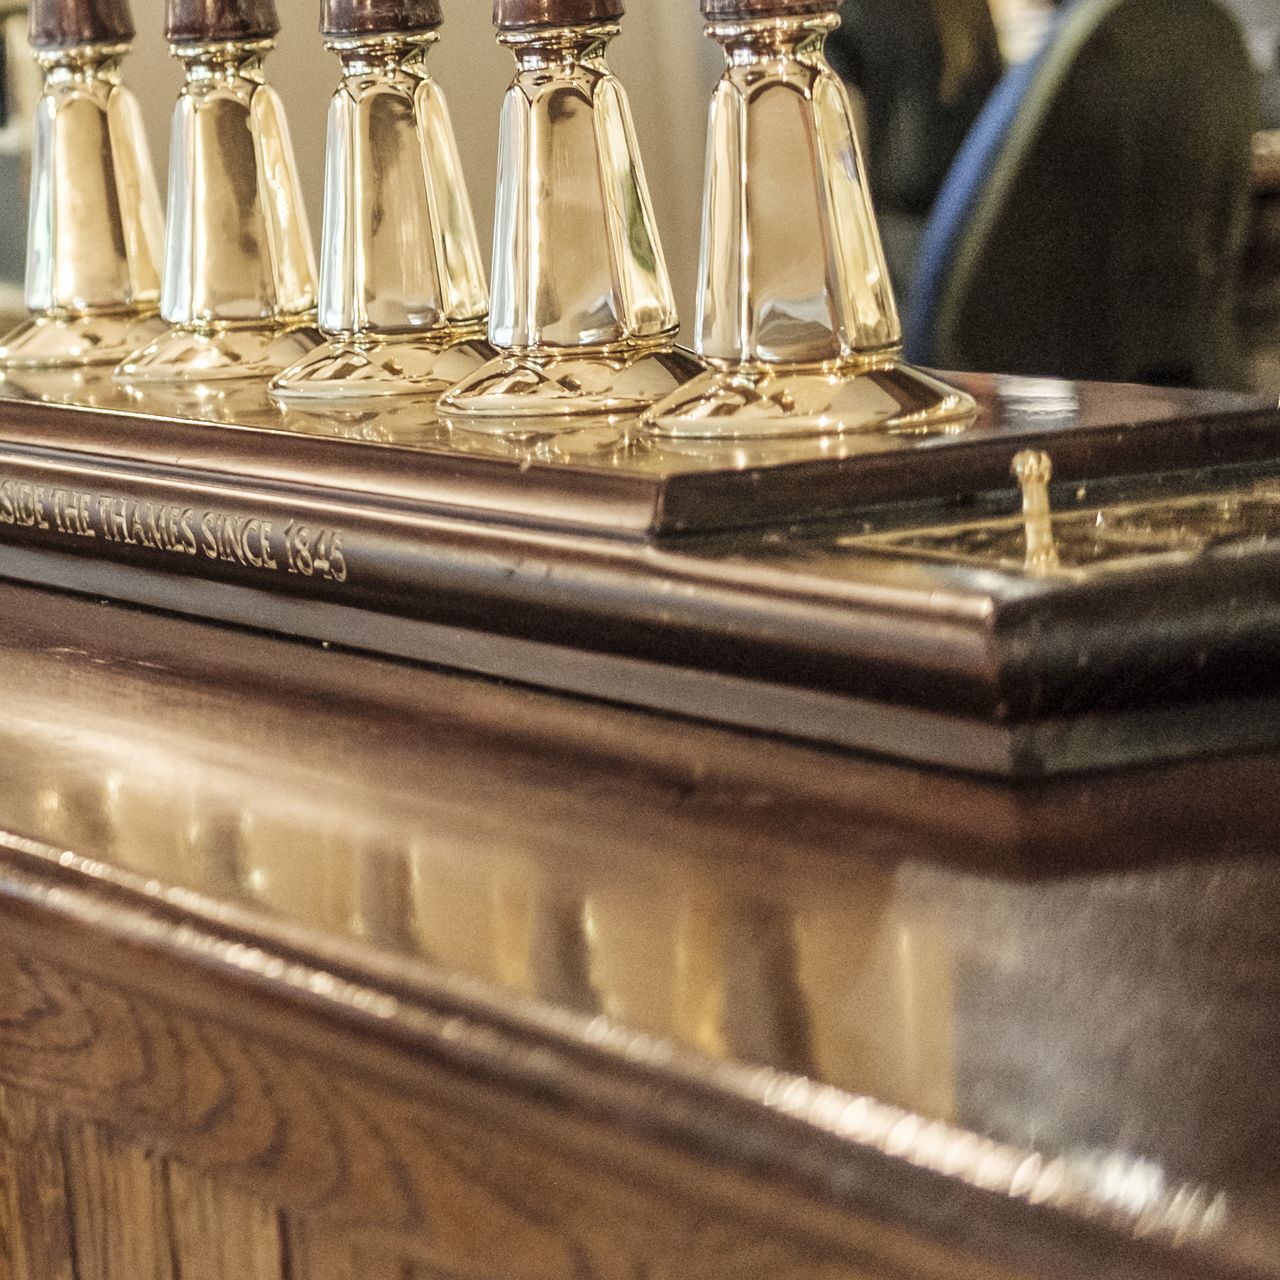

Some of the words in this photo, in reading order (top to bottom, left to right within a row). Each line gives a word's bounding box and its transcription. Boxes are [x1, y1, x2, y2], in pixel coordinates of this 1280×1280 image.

[51, 487, 96, 538] THE
[98, 495, 198, 556] THAMES
[200, 511, 278, 569] SINCE
[283, 518, 348, 583] 1845
